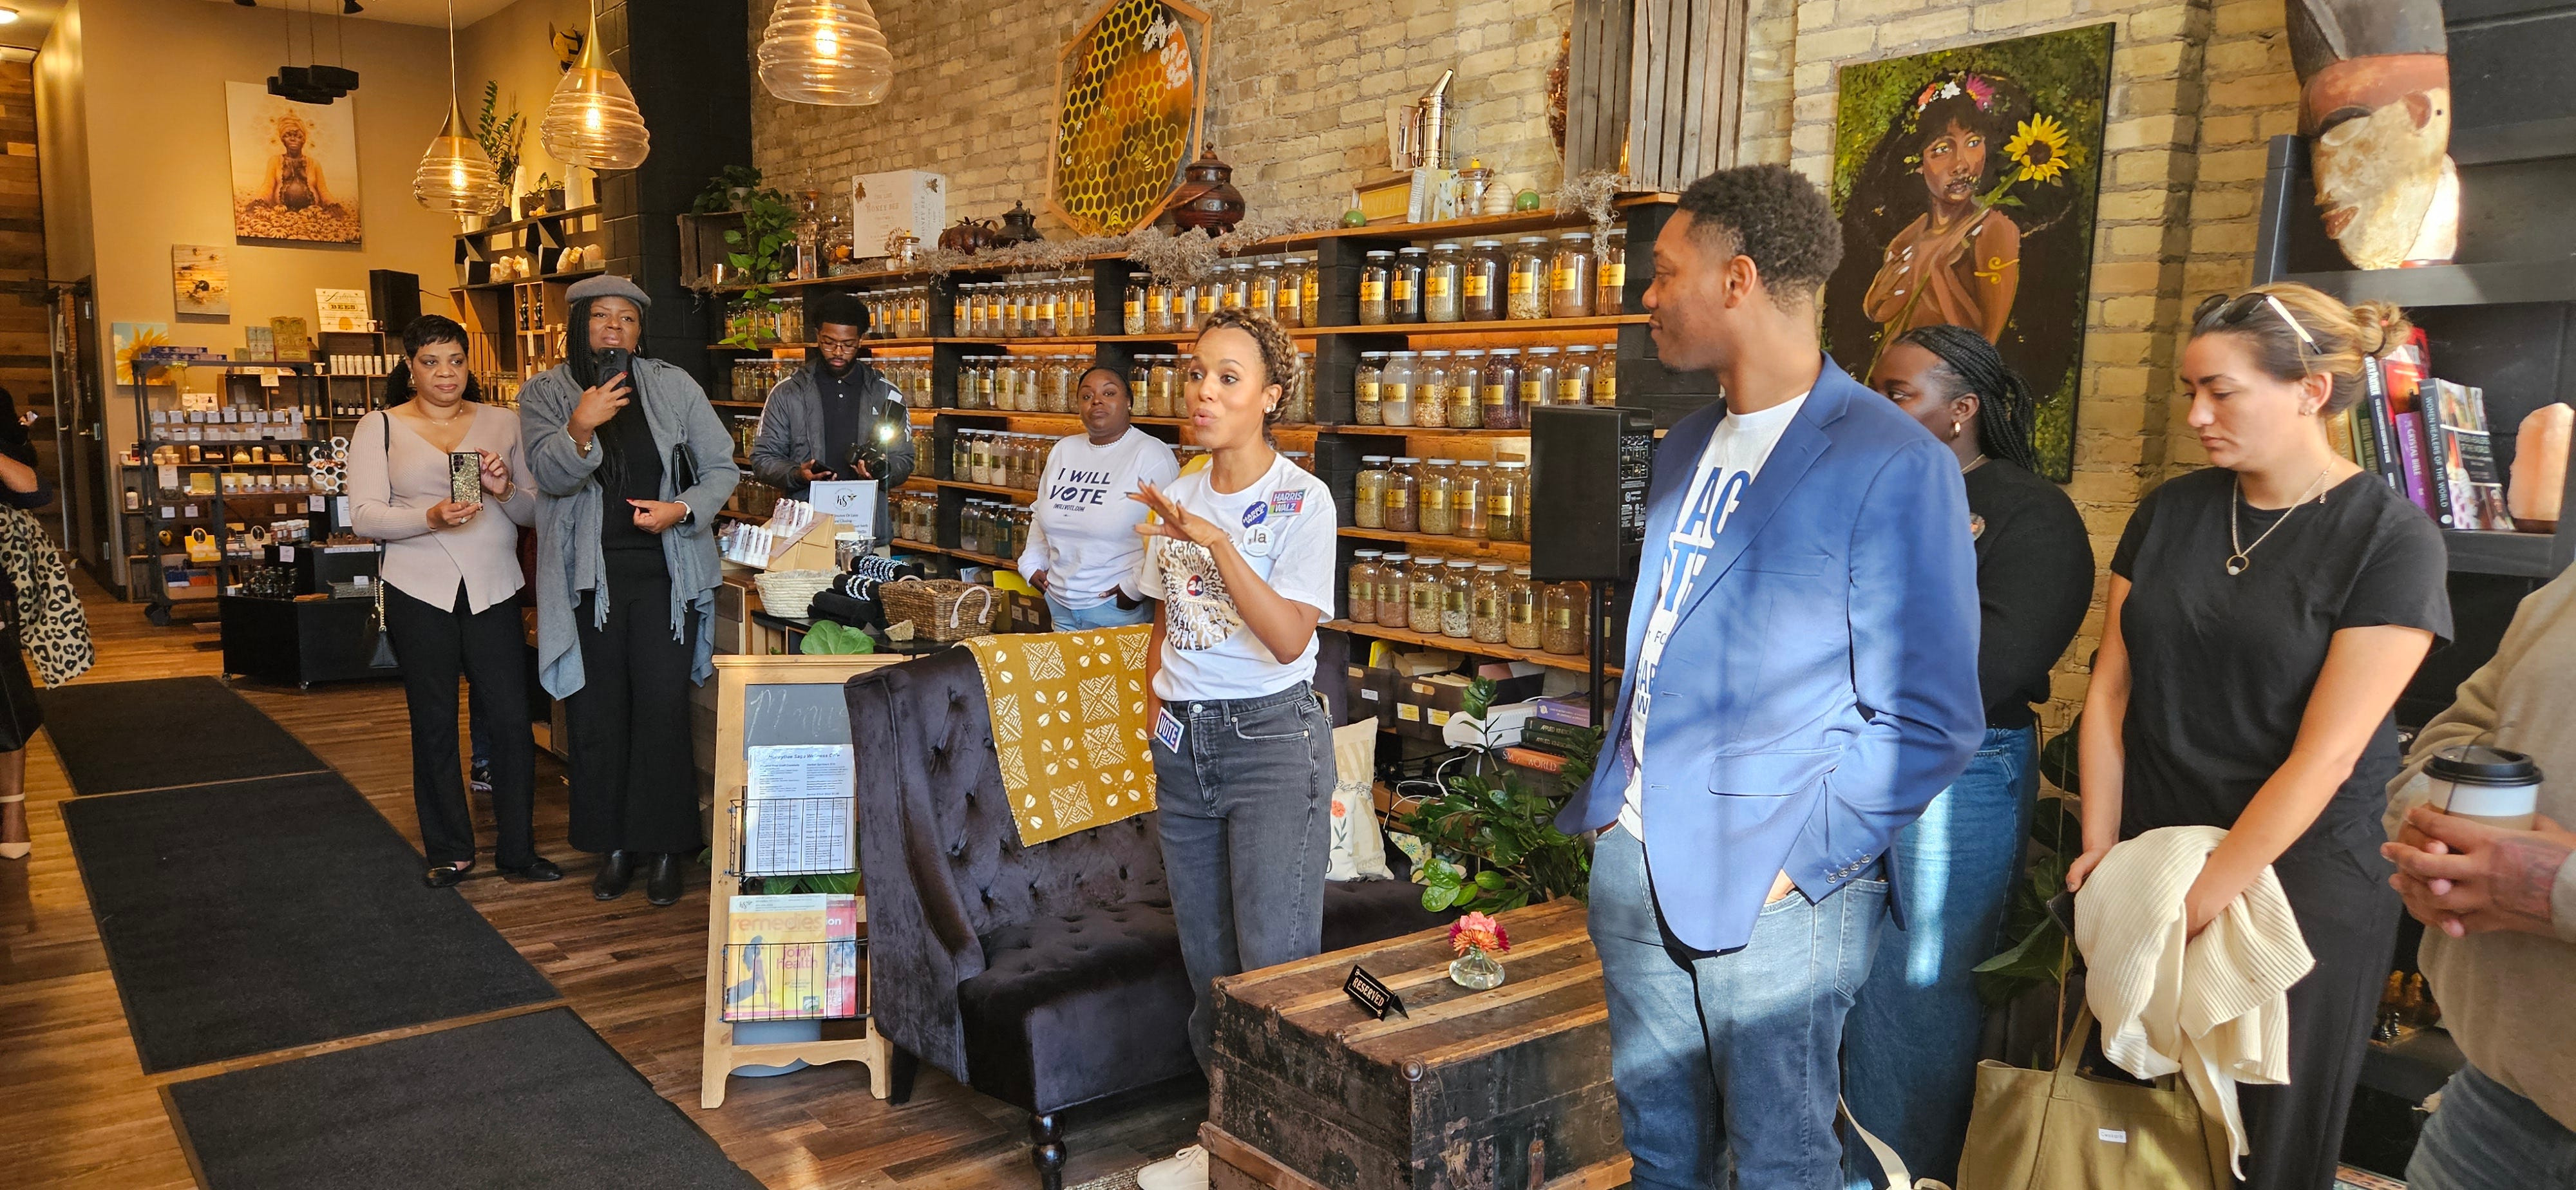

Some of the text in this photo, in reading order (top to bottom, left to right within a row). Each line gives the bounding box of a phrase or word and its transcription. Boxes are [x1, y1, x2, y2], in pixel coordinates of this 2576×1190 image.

[865, 202, 887, 212] HONEY
[2425, 396, 2448, 508] WOMEN HEALERS OF THE WORLD
[1057, 468, 1111, 485] I WILL
[1049, 485, 1107, 505] VOTE
[1273, 491, 1303, 502] HARRIS
[1053, 503, 1086, 512] IWILLVOTE.COM
[1274, 502, 1296, 513] WALZ
[1187, 580, 1203, 592] 24
[1158, 715, 1179, 745] VOTE
[732, 913, 822, 931] remedies
[784, 946, 812, 959] joint
[776, 958, 818, 970] health
[1352, 977, 1385, 1007] RESERVED
